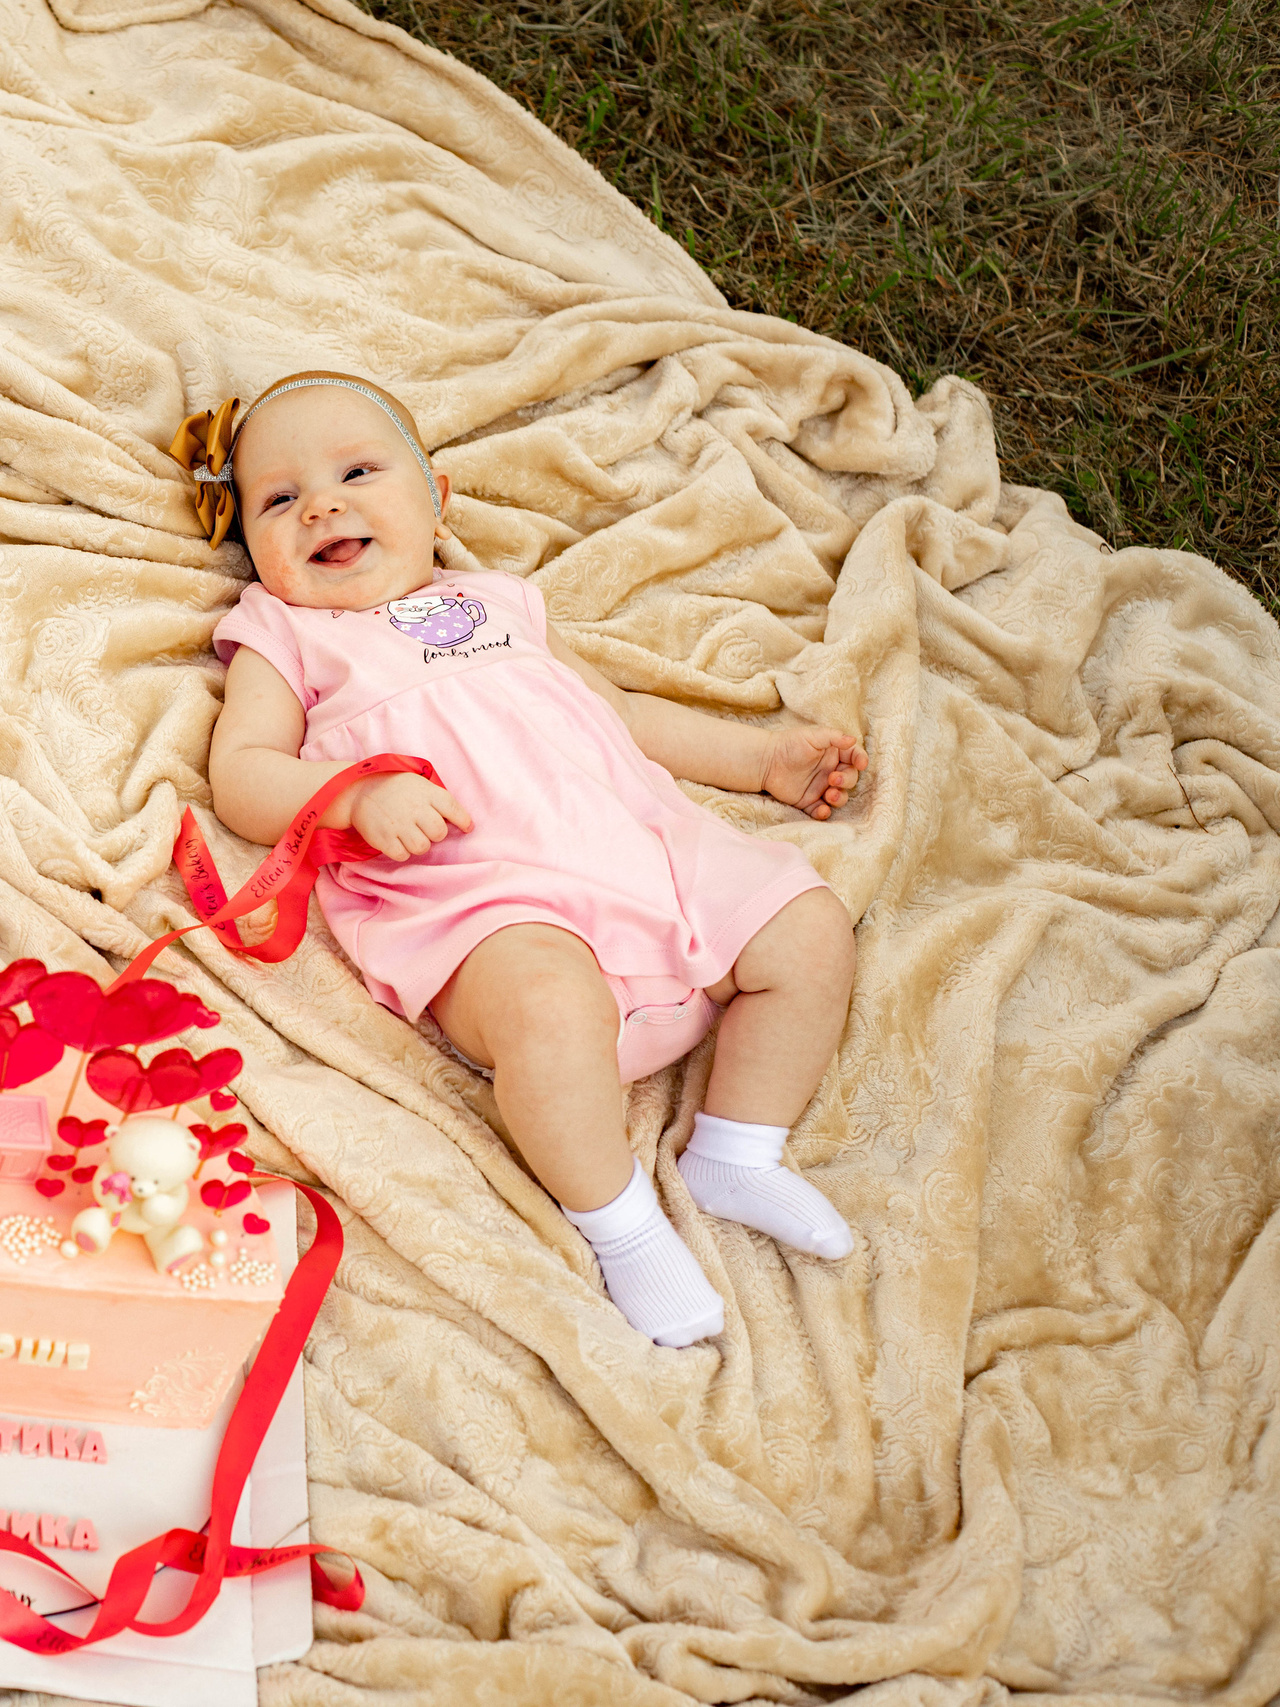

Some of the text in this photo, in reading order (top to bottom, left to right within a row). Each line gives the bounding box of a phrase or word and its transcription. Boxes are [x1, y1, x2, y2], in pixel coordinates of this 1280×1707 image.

[472, 633, 513, 653] mood
[185, 838, 210, 882] Bakery
[250, 810, 318, 898] Ellen's Bakery
